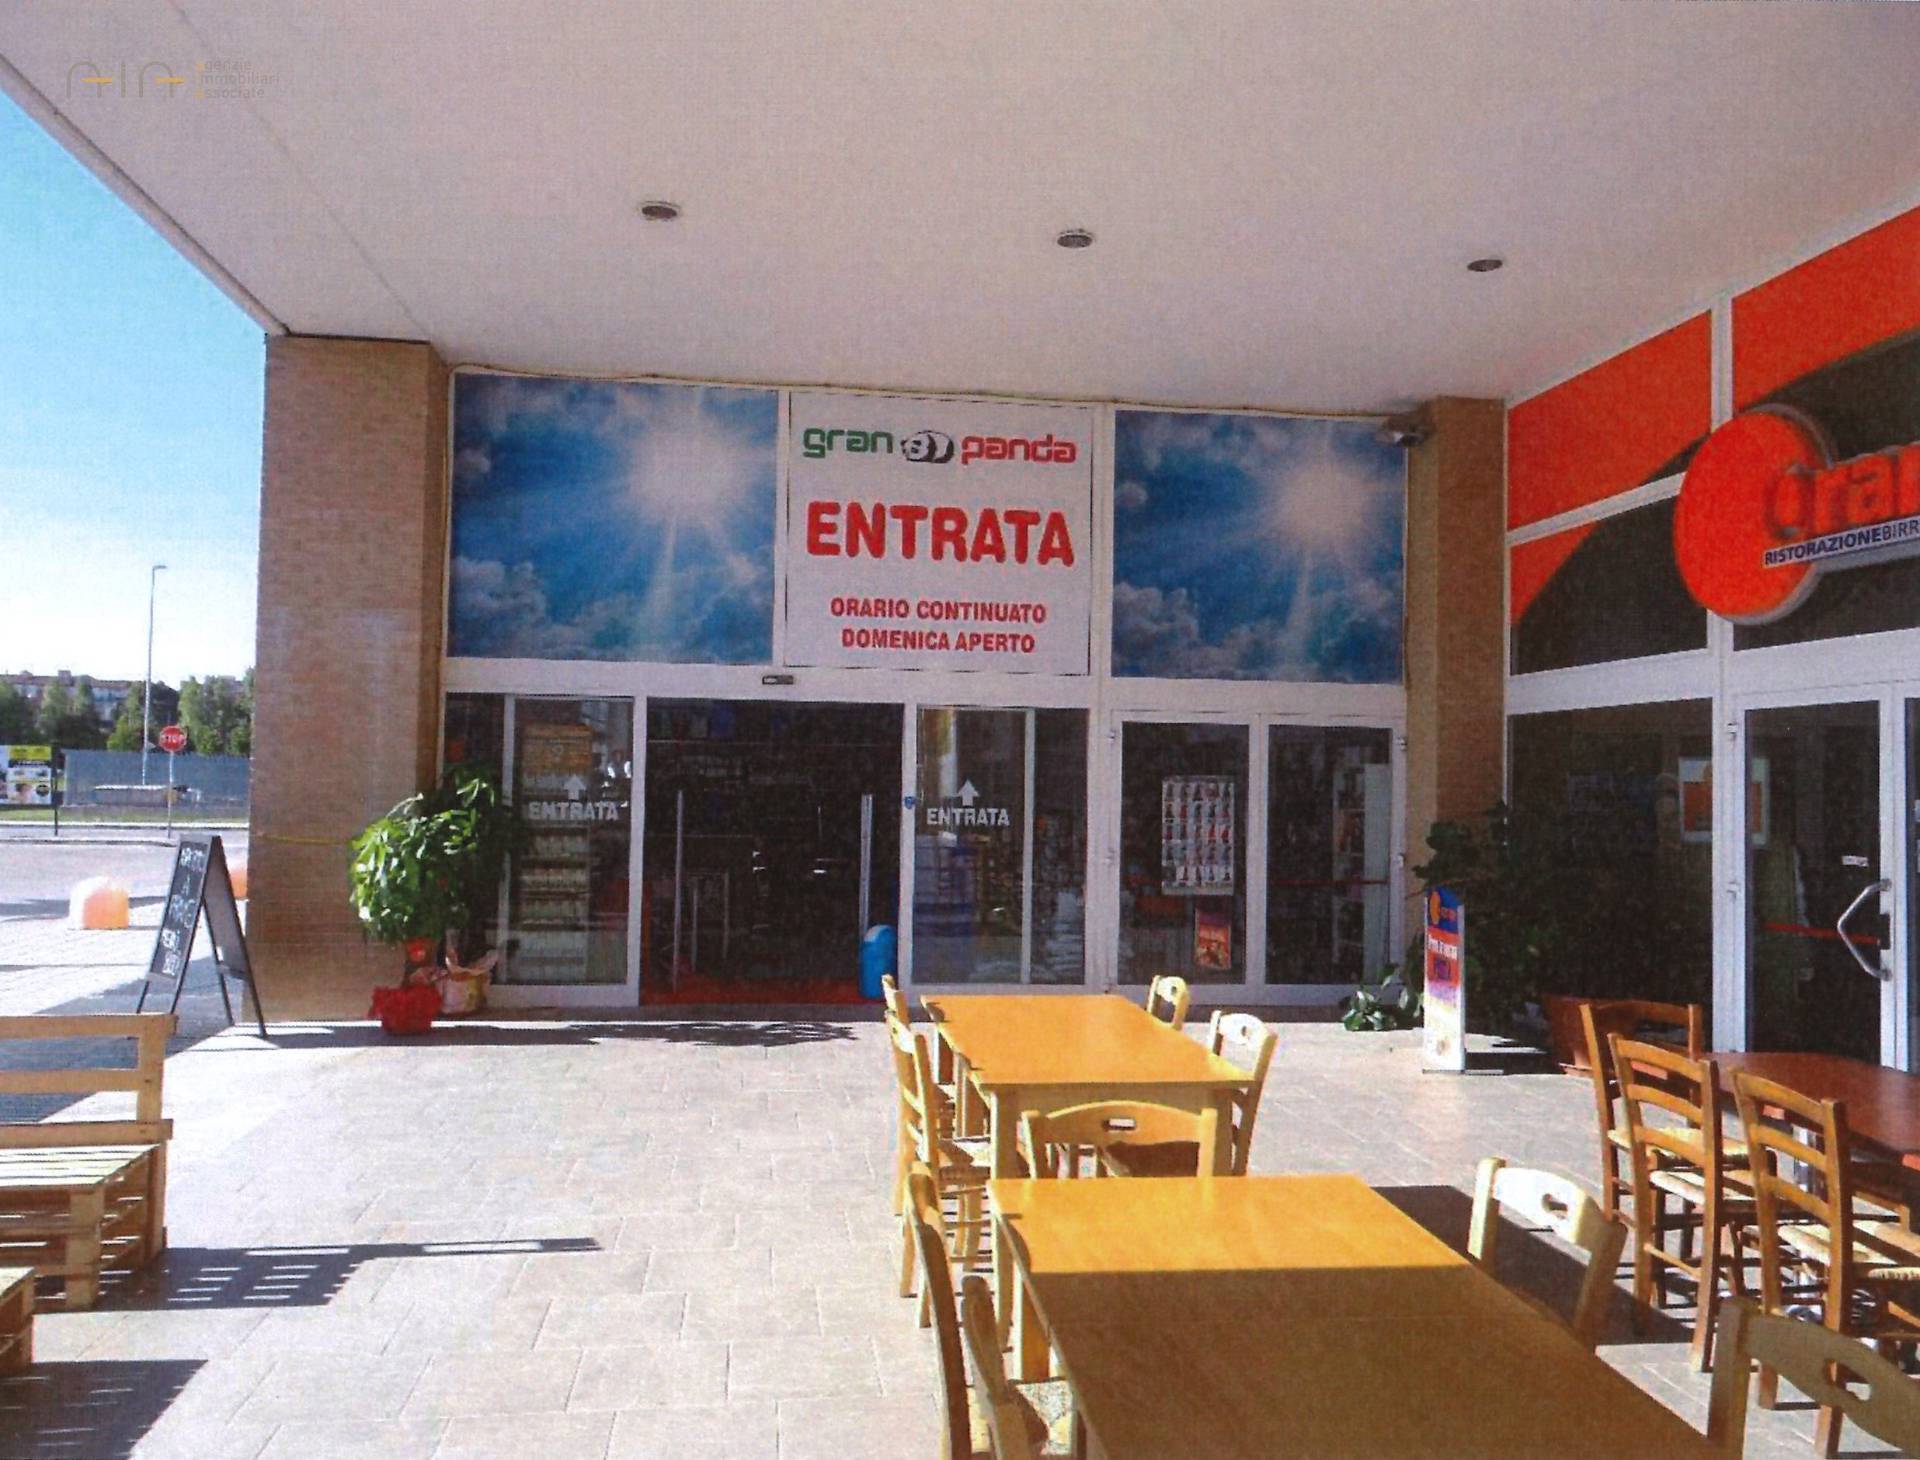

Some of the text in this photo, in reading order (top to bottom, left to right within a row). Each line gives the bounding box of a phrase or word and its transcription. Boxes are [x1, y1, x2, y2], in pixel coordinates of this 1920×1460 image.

[802, 428, 1077, 465] gran panda
[806, 501, 1075, 567] ENTRATA
[830, 597, 1046, 624] ORARIO CONTINUATO
[841, 628, 1035, 653] DOMENICA APERTO
[528, 801, 619, 821] ENTRATA
[926, 807, 1011, 826] ENTRATA
